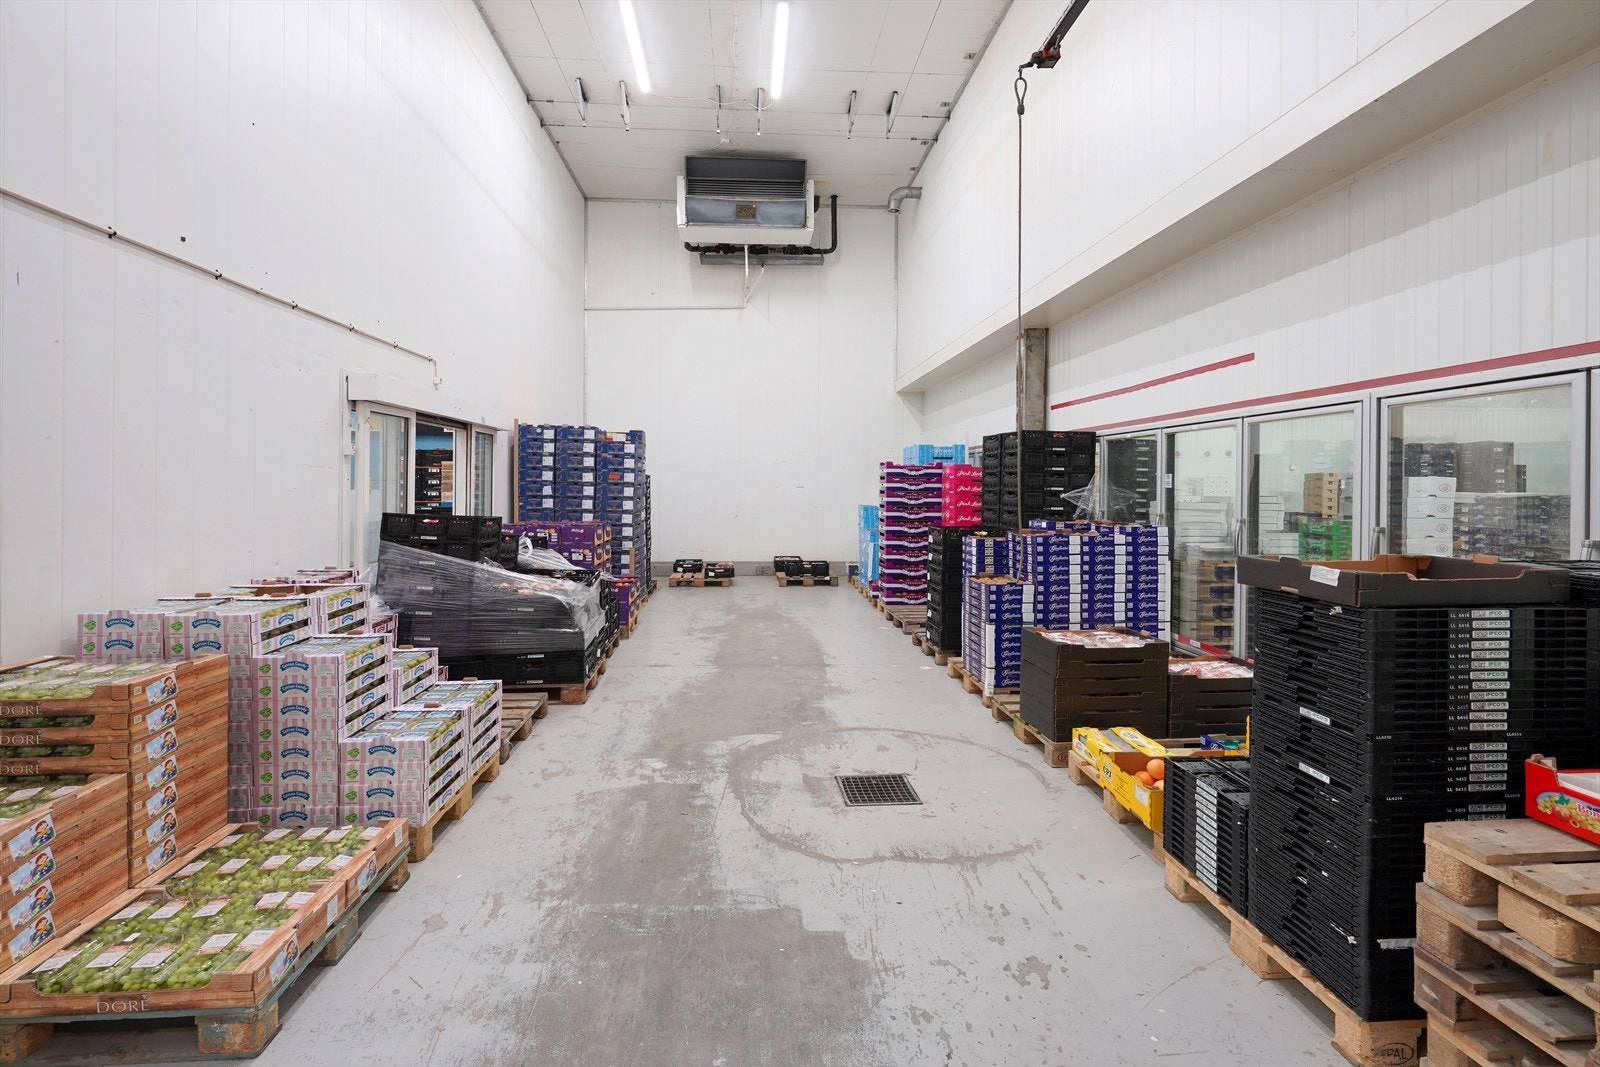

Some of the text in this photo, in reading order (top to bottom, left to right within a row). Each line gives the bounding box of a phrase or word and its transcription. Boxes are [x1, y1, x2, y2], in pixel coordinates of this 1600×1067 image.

[120, 618, 133, 626] Candy
[295, 705, 308, 713] Candy
[295, 748, 308, 756] Candy
[296, 791, 308, 799] Candy
[380, 788, 393, 796] Candy
